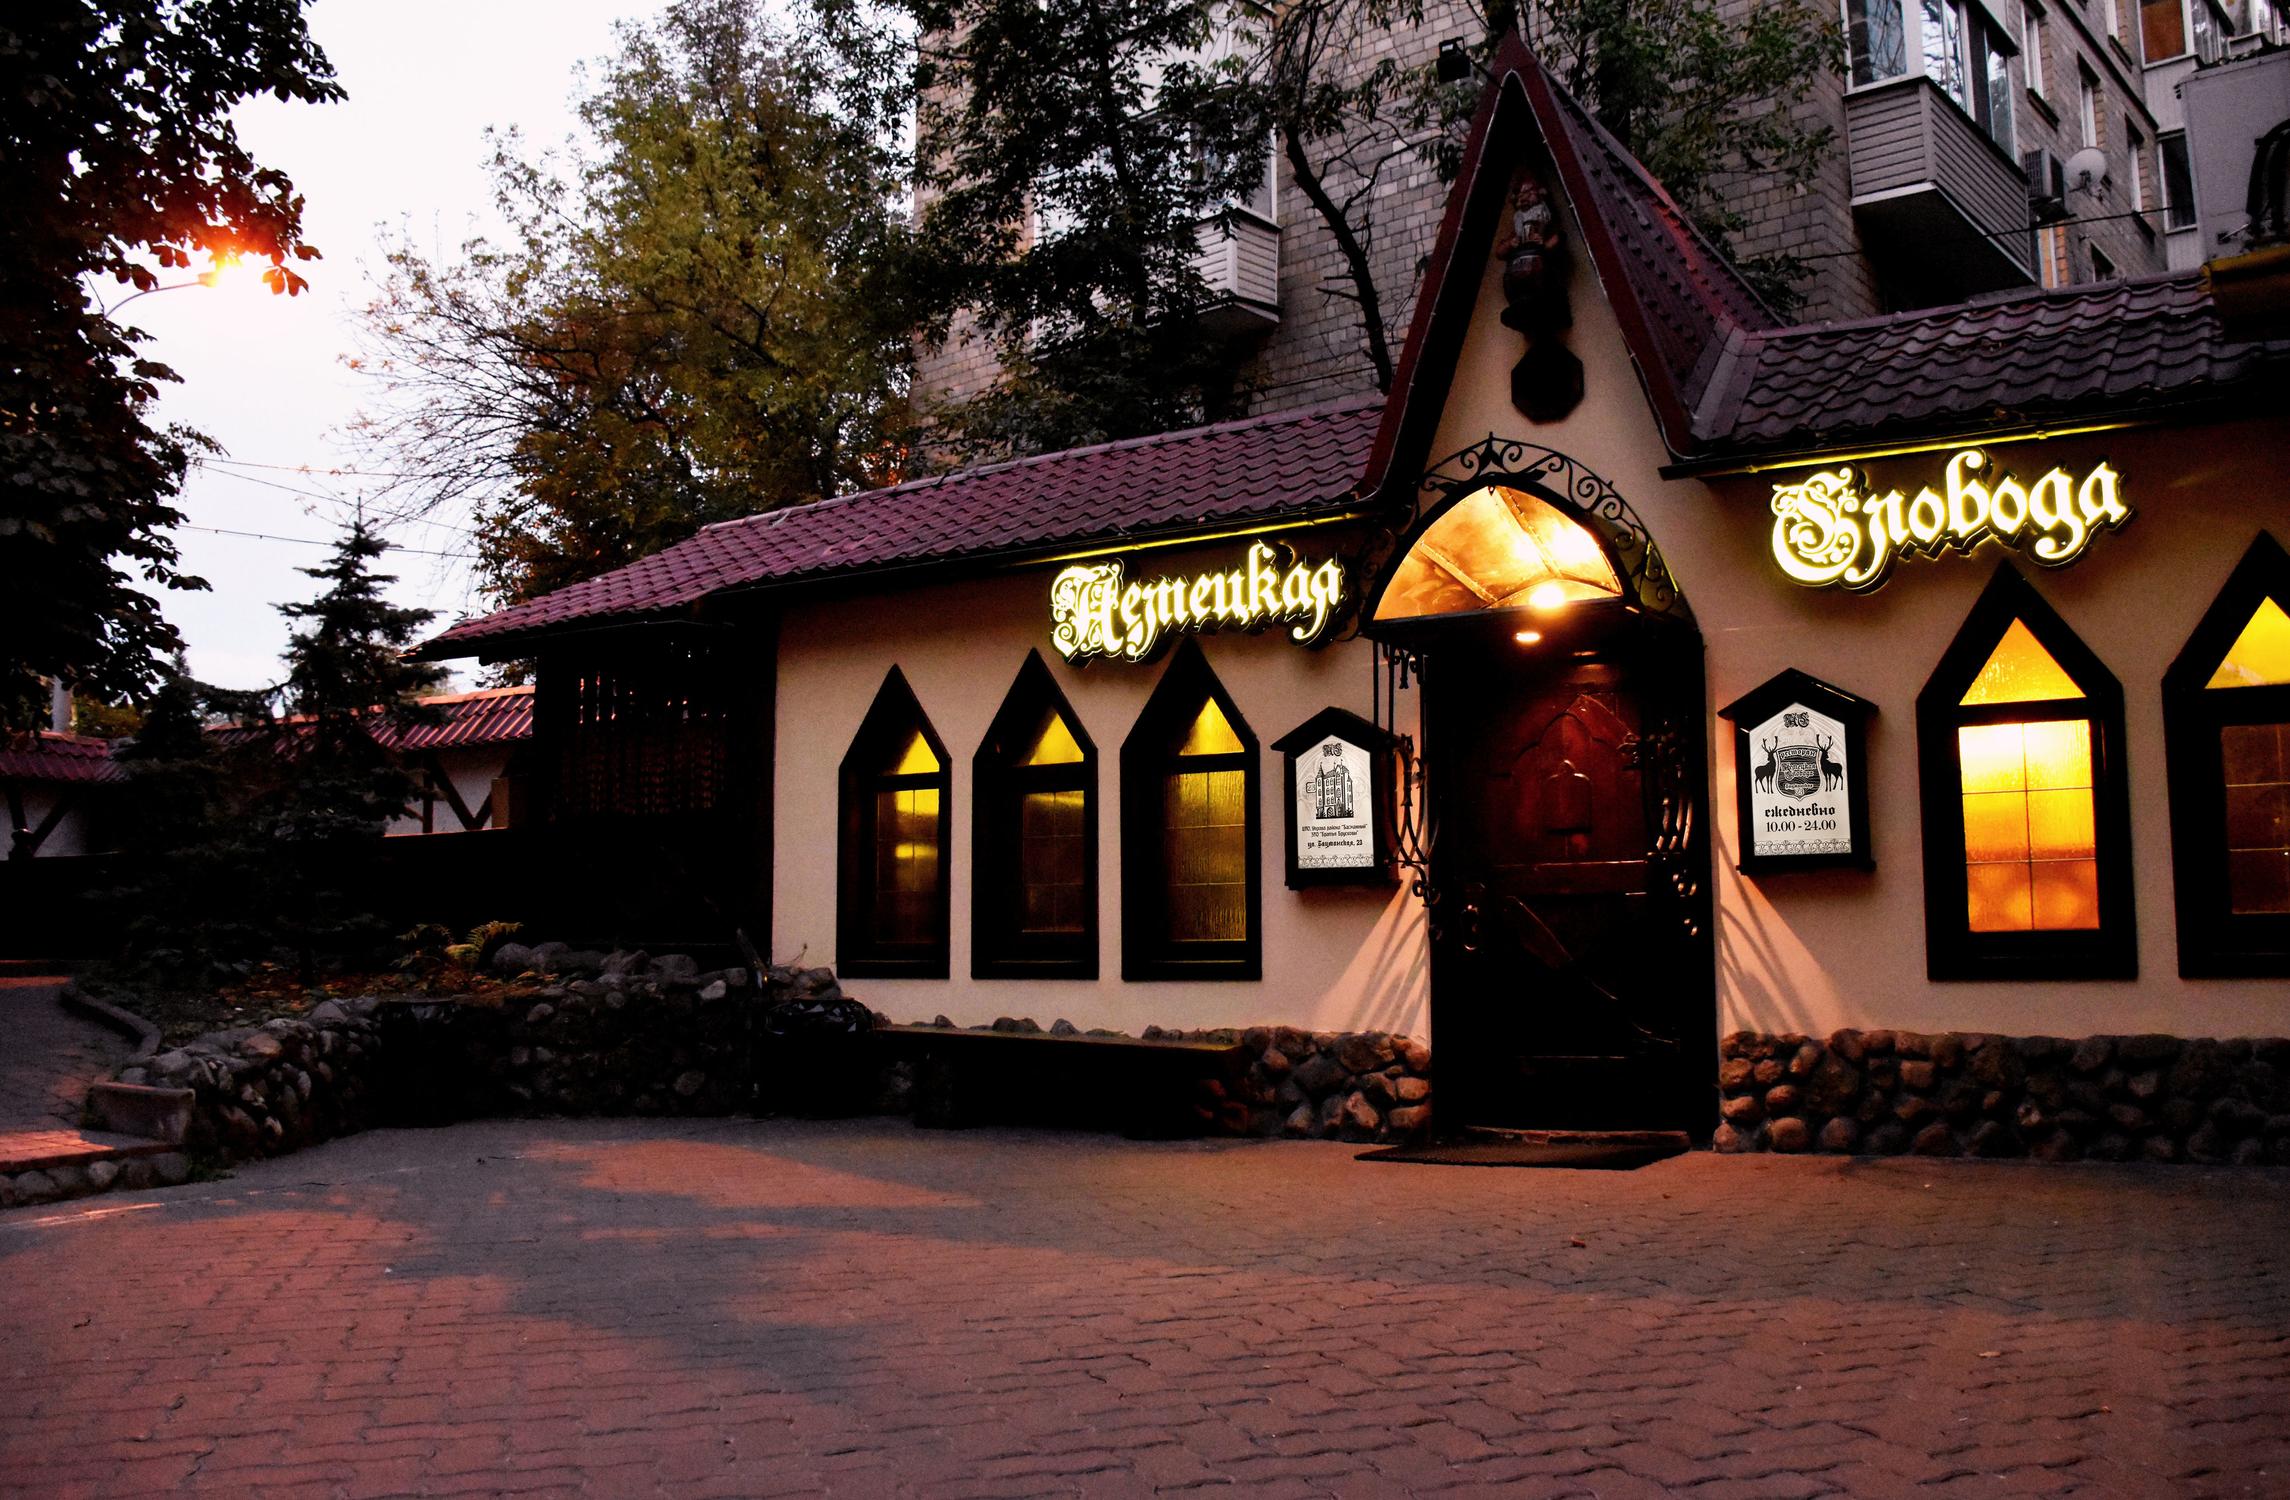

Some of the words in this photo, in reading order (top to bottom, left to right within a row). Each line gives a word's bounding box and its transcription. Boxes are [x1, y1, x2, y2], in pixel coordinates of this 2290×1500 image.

[1050, 541, 1343, 657] Немецкая
[1765, 802, 1836, 818] ежедневно
[1766, 820, 1796, 832] 10.00
[1804, 819, 1837, 831] 24.00
